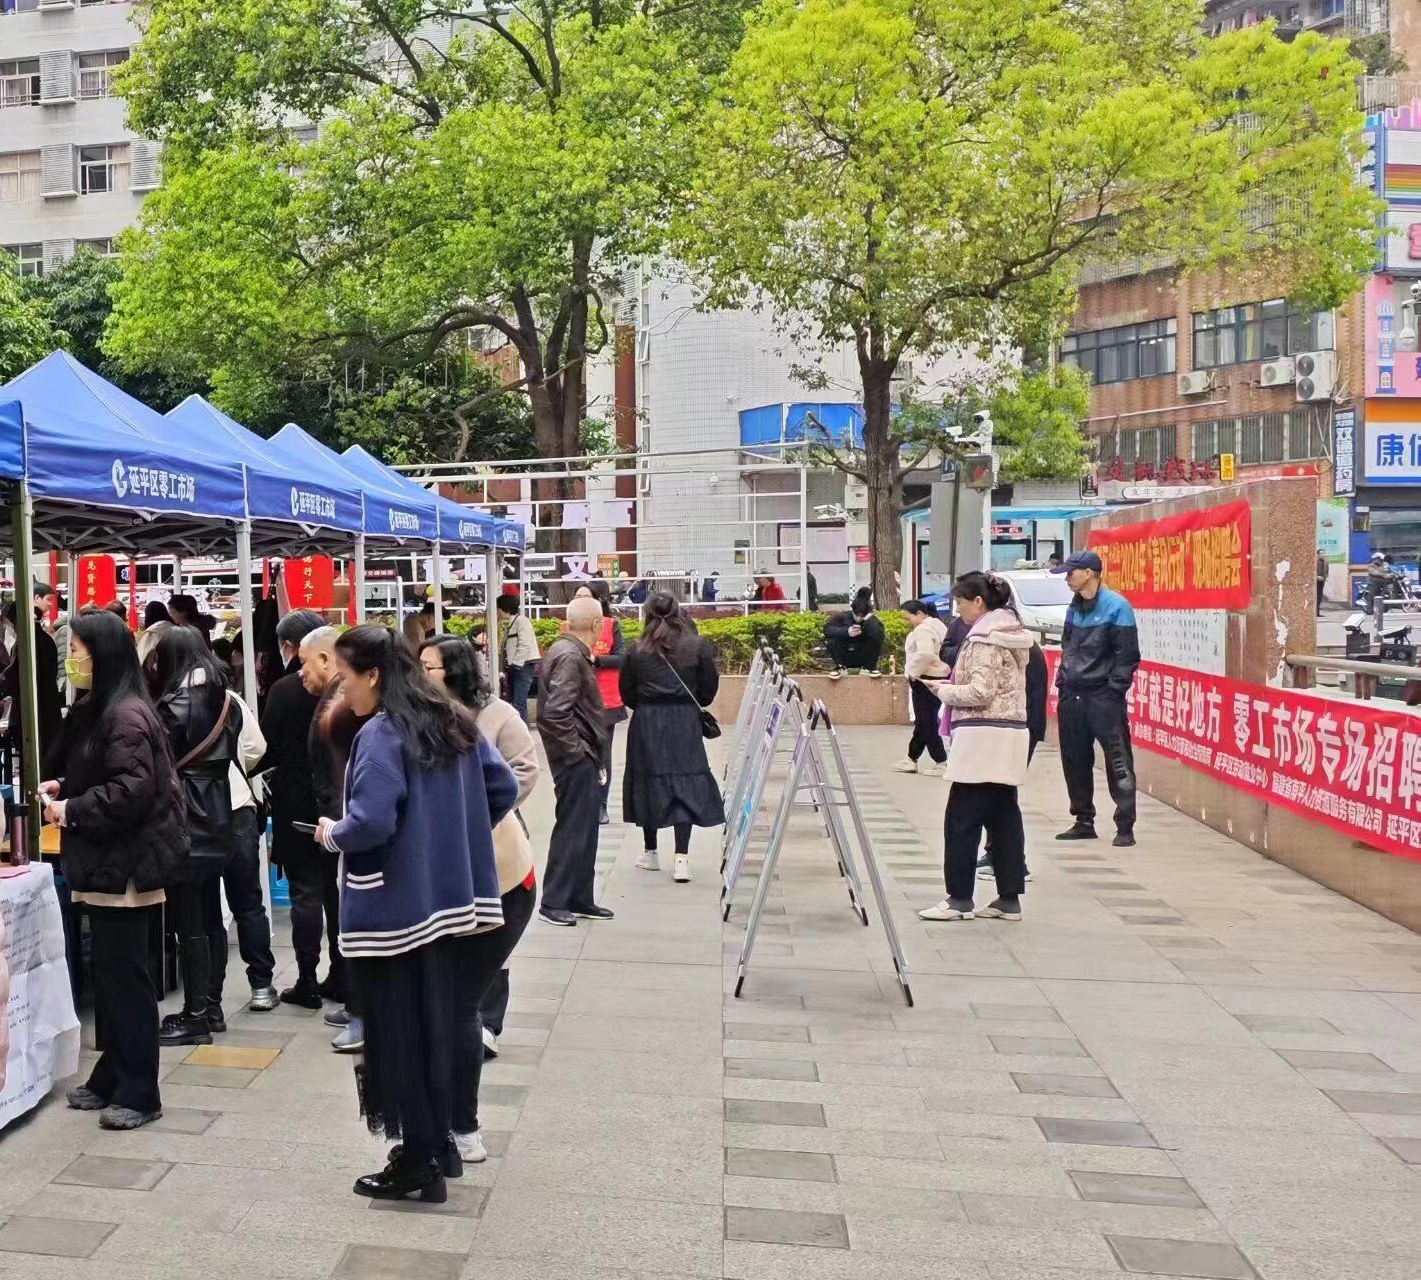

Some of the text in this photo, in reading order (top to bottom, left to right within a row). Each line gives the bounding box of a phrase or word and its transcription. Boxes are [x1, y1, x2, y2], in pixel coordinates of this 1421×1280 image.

[127, 465, 196, 503] 延平区零工市场
